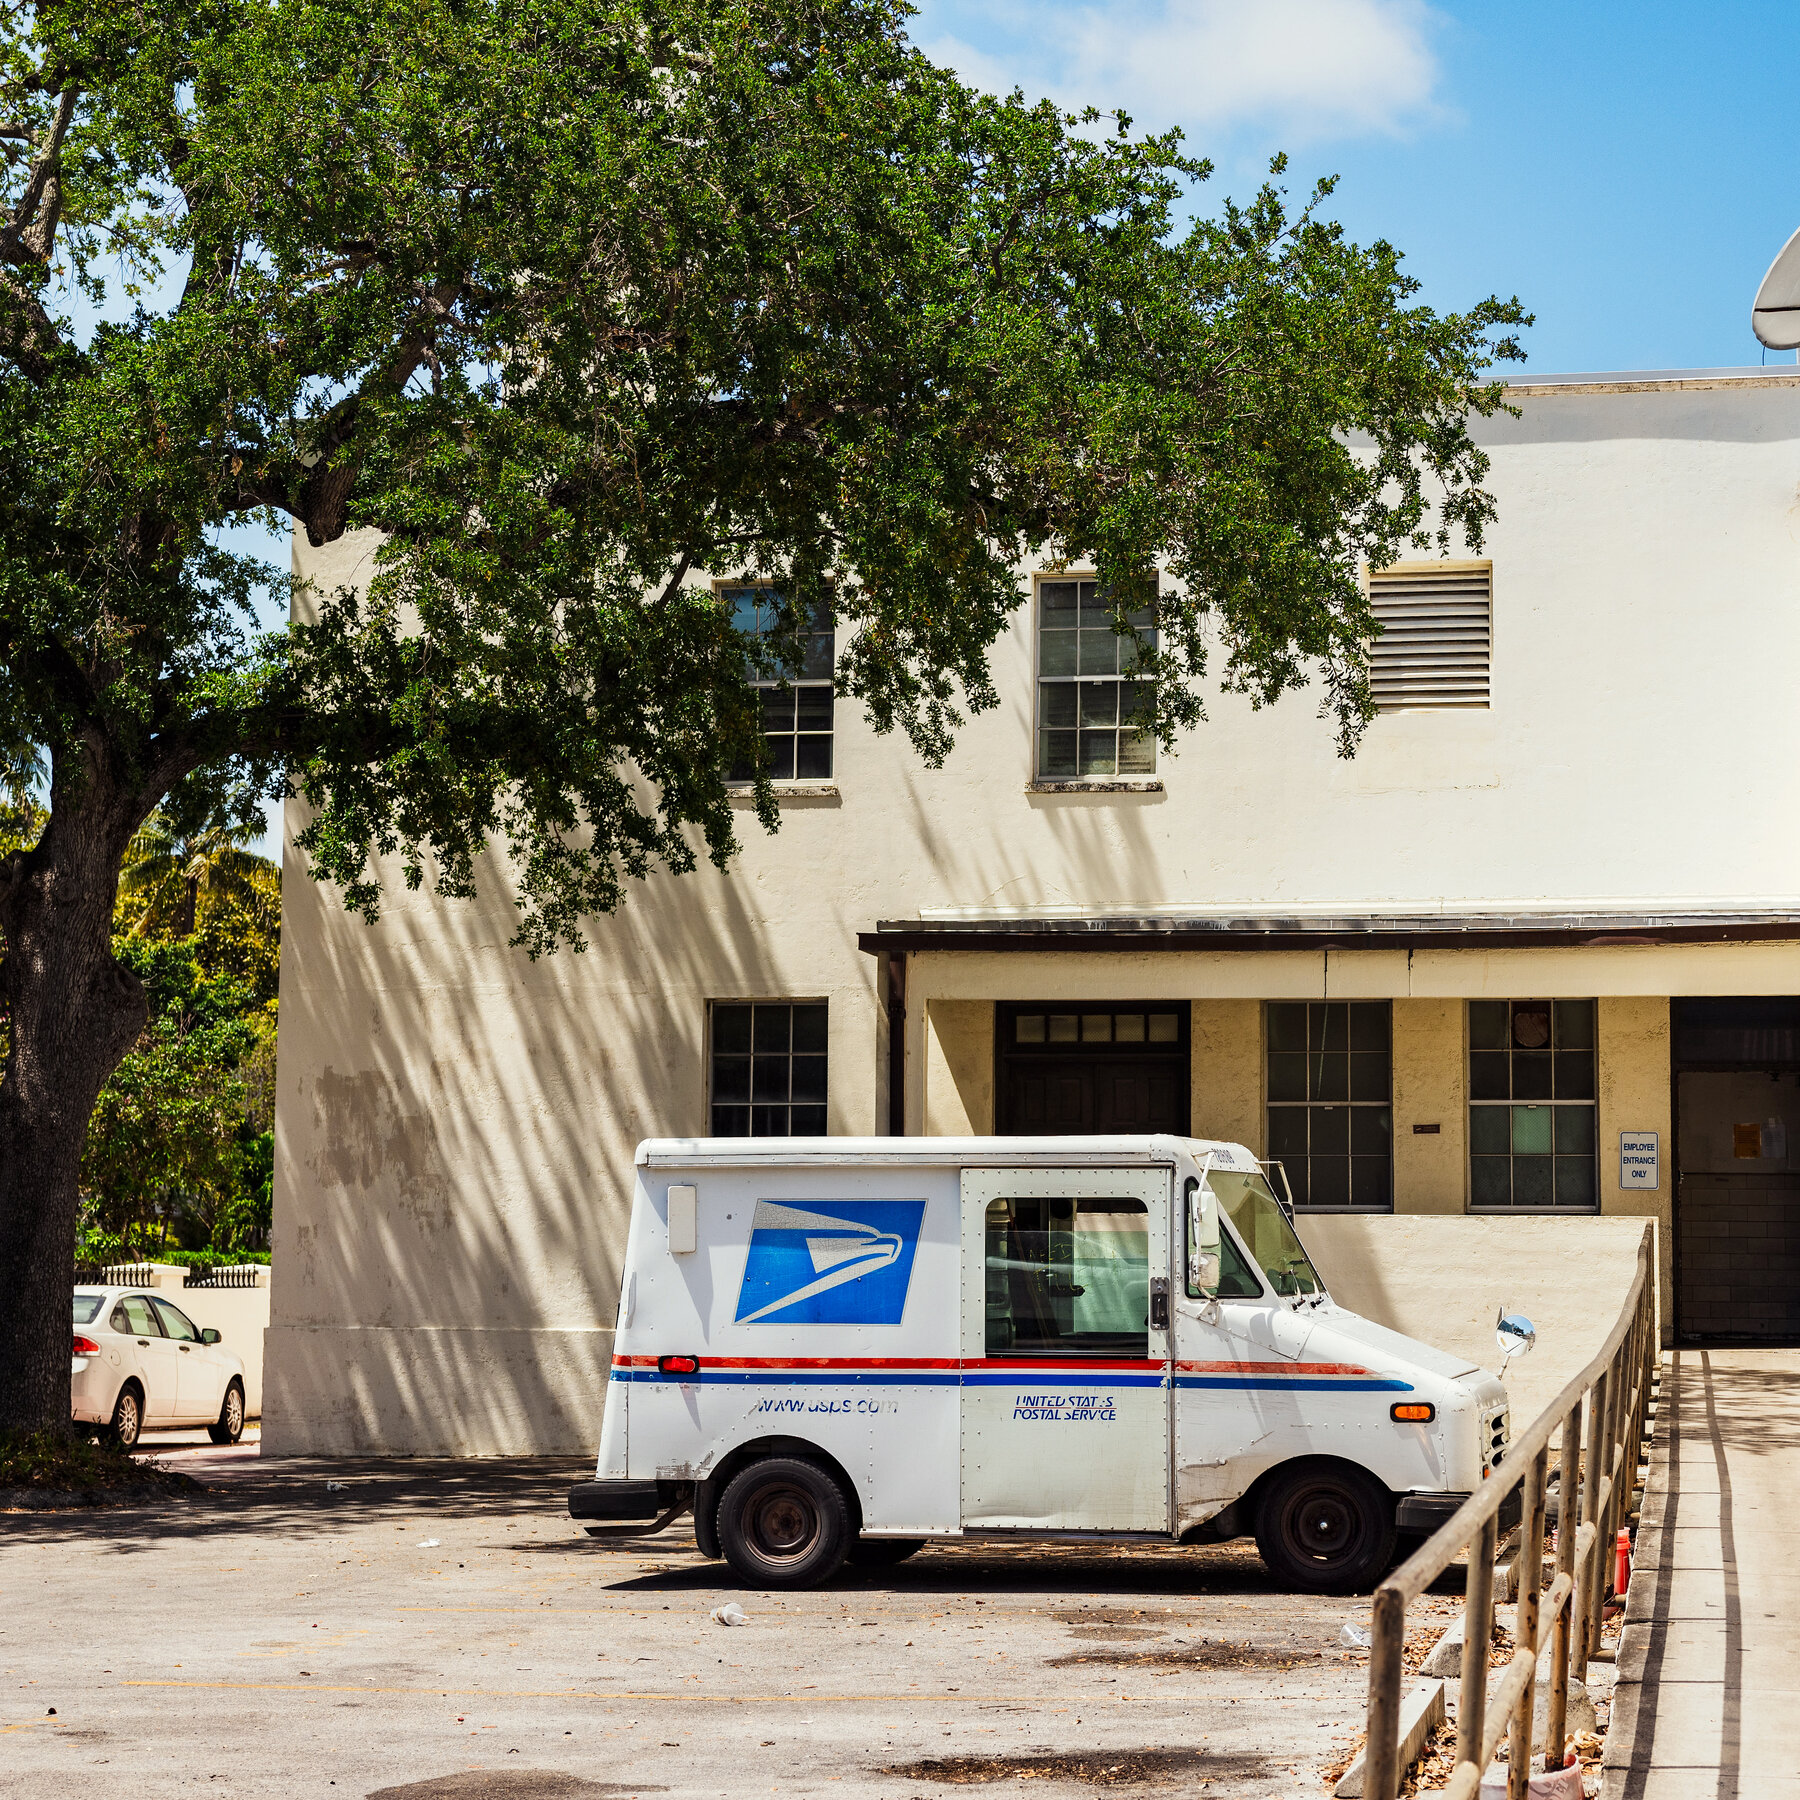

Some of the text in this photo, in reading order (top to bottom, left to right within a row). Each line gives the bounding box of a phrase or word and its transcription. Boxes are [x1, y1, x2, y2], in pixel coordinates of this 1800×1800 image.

[1623, 1143, 1655, 1151] EMPLOYEE
[1623, 1156, 1656, 1165] ENTRANCE
[1631, 1169, 1647, 1178] ONLY
[1068, 1396, 1114, 1408] STATS
